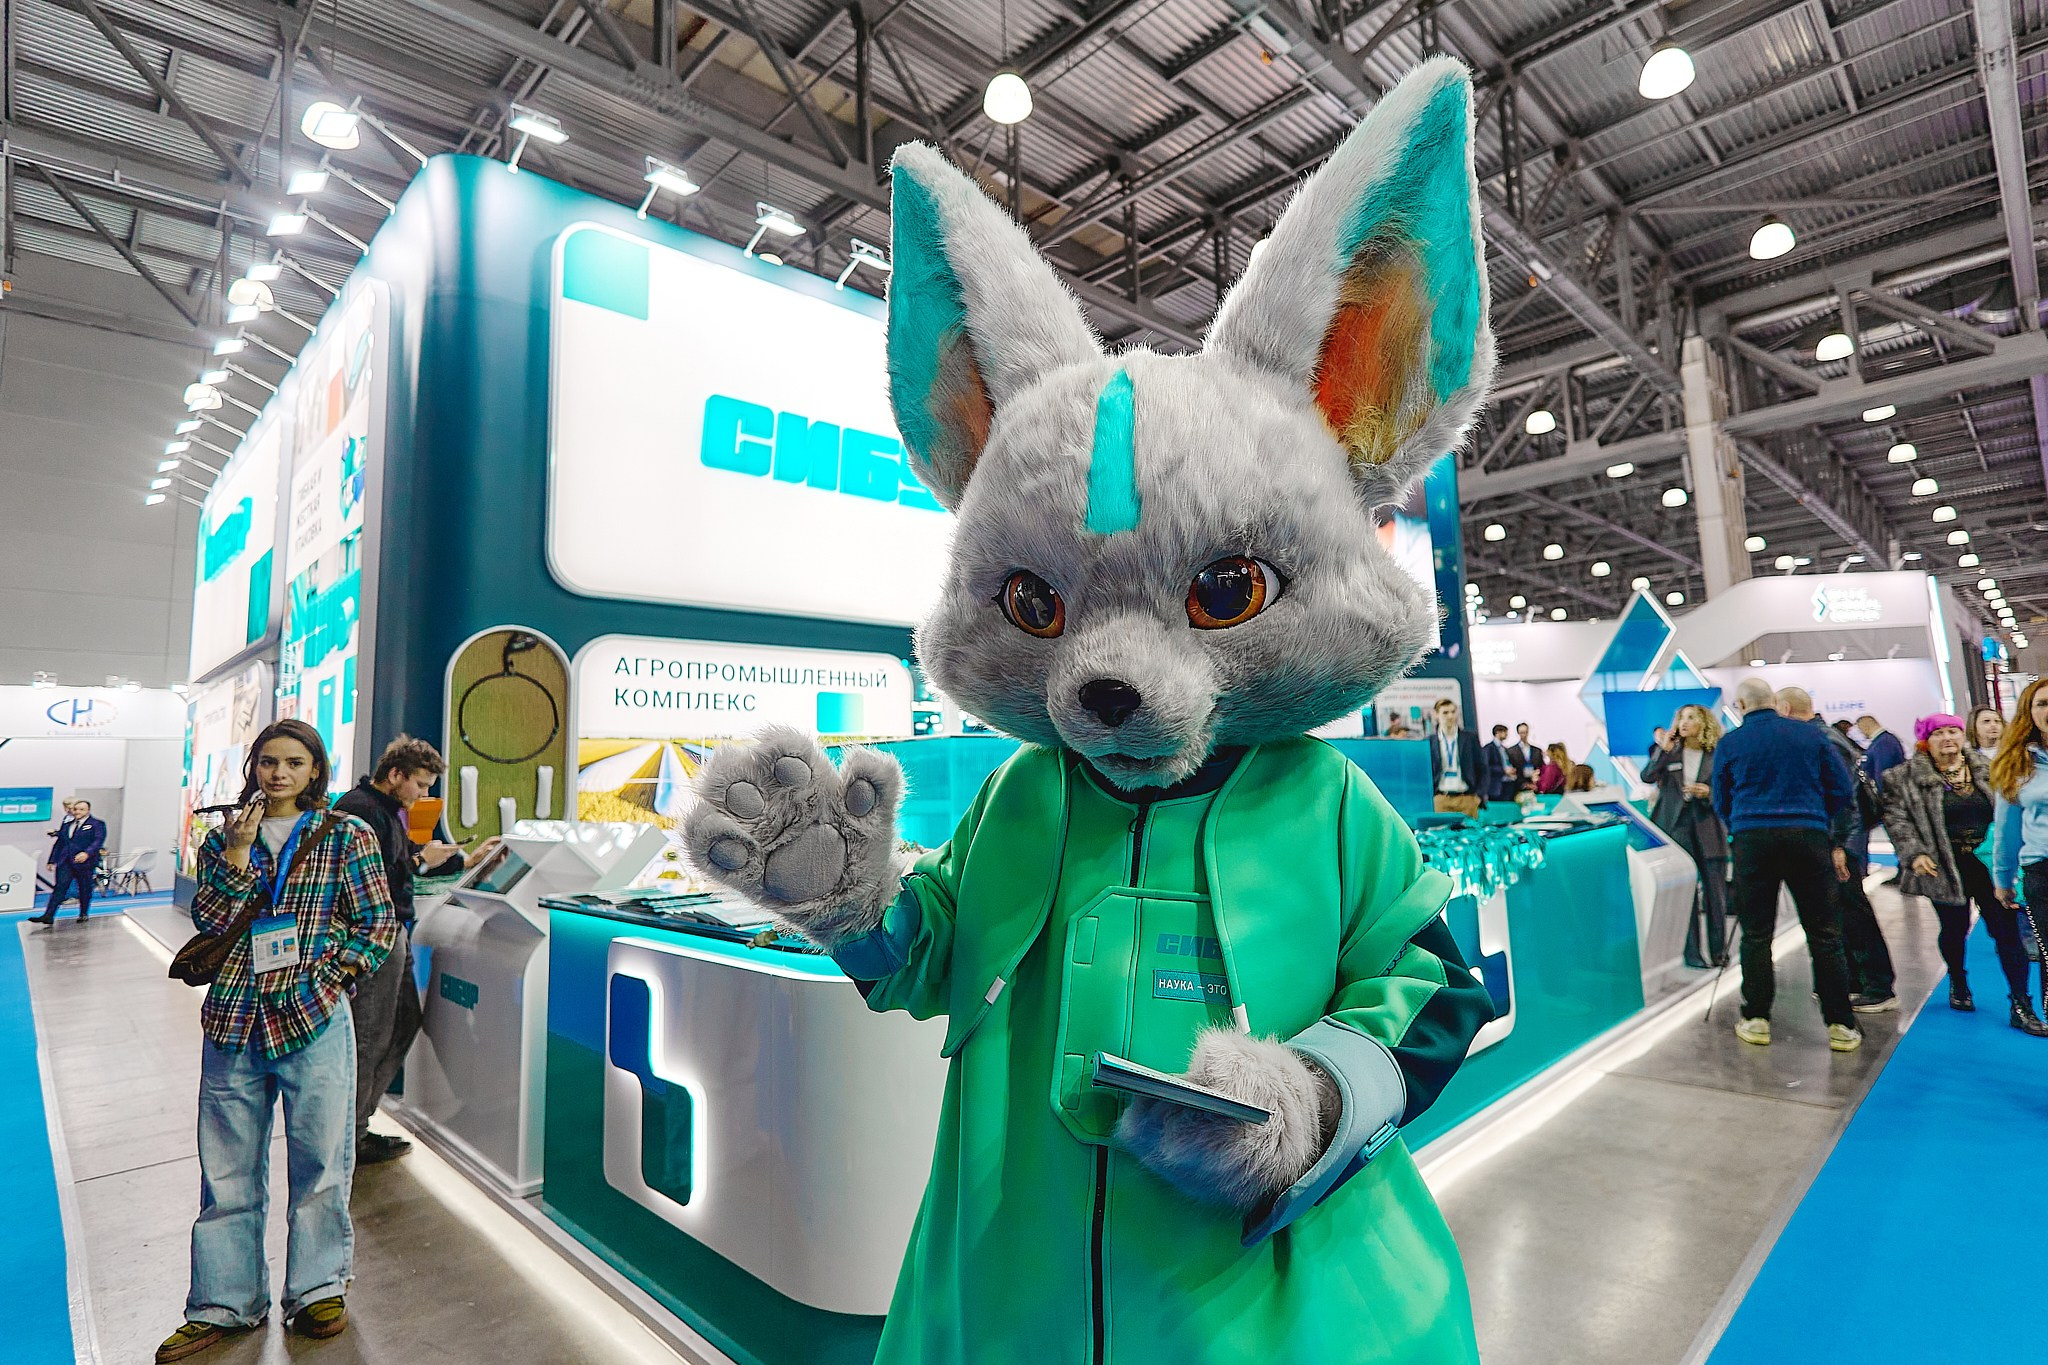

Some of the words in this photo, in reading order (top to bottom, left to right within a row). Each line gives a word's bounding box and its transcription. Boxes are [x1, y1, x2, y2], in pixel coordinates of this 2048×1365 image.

[615, 657, 887, 688] АГРОПРОМЫШЛЕННЫЙ
[615, 688, 756, 712] КОМПЛЕКС
[1158, 978, 1194, 991] НАУКА
[1207, 983, 1227, 995] ЭТО
